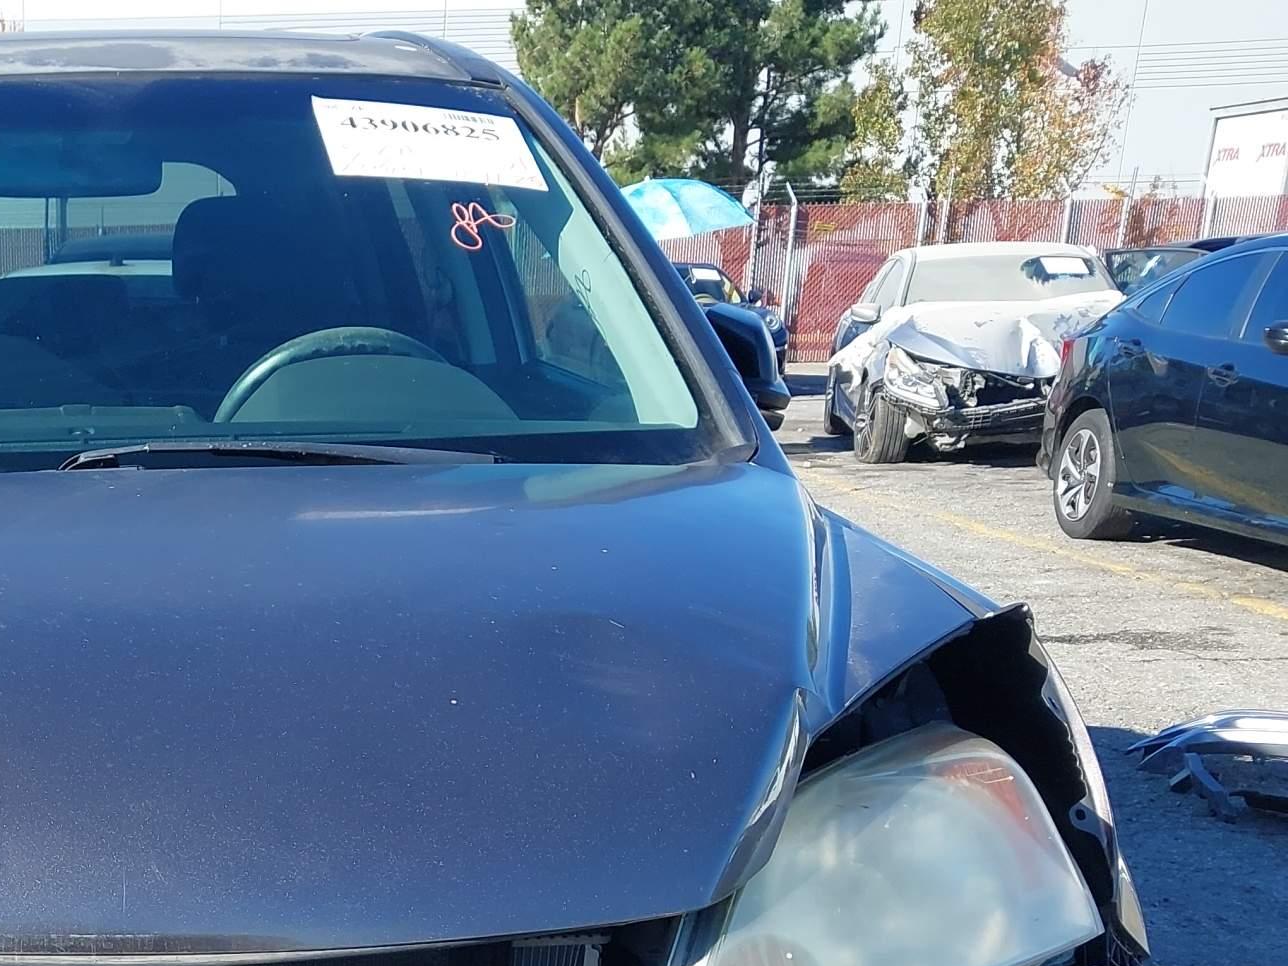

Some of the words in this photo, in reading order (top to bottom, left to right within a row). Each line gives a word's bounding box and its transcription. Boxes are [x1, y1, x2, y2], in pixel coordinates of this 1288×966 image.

[339, 115, 501, 142] 43906825
[1214, 147, 1240, 165] XTRA
[1256, 142, 1287, 162] XTRA
